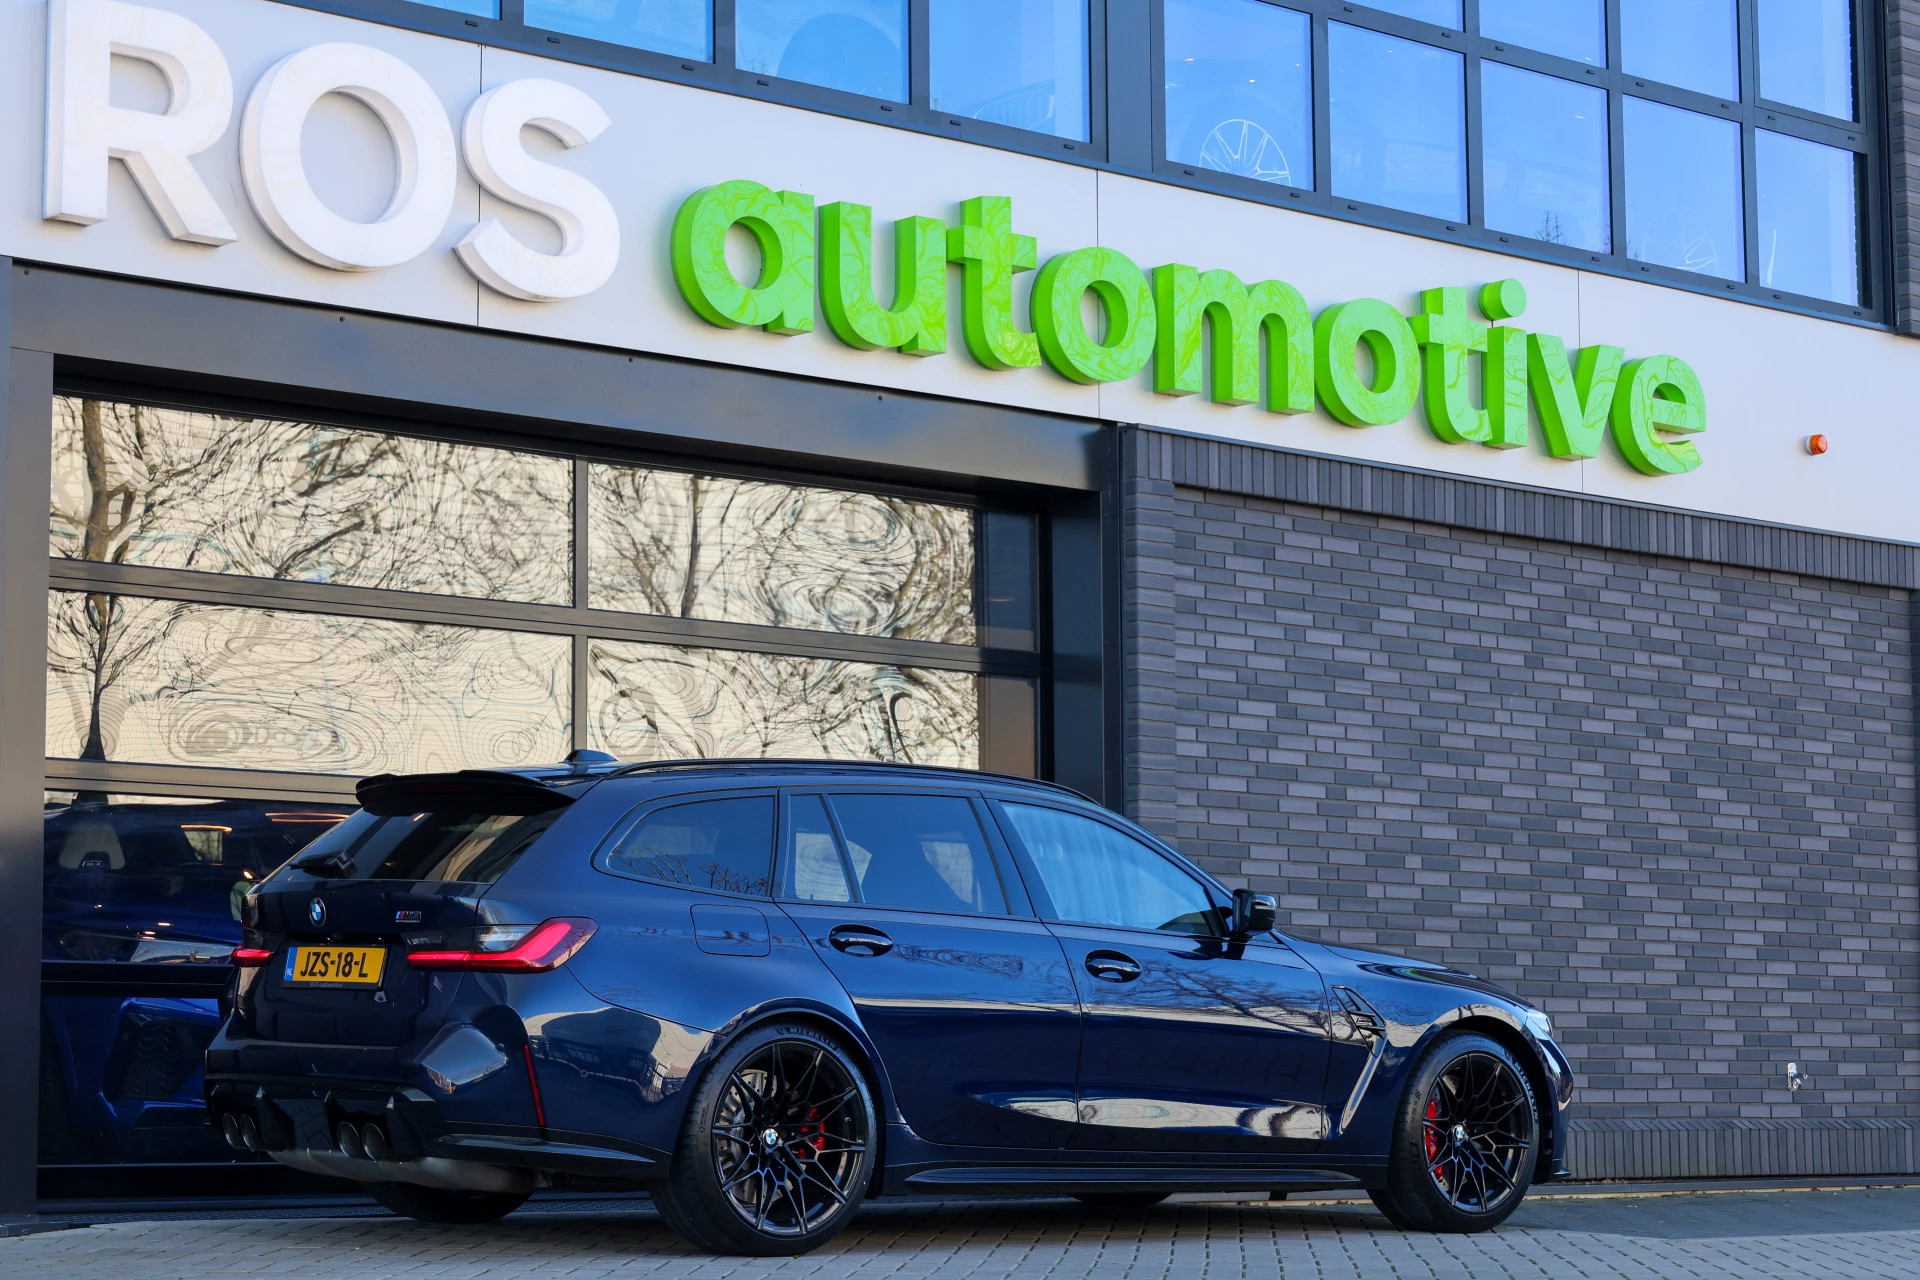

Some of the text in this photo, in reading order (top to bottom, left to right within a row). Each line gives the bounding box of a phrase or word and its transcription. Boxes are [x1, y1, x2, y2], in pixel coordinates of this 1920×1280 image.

[43, 0, 1707, 477] ROS automotive
[300, 951, 369, 978] JZS-18-L
[789, 1027, 837, 1049] MICHELIN
